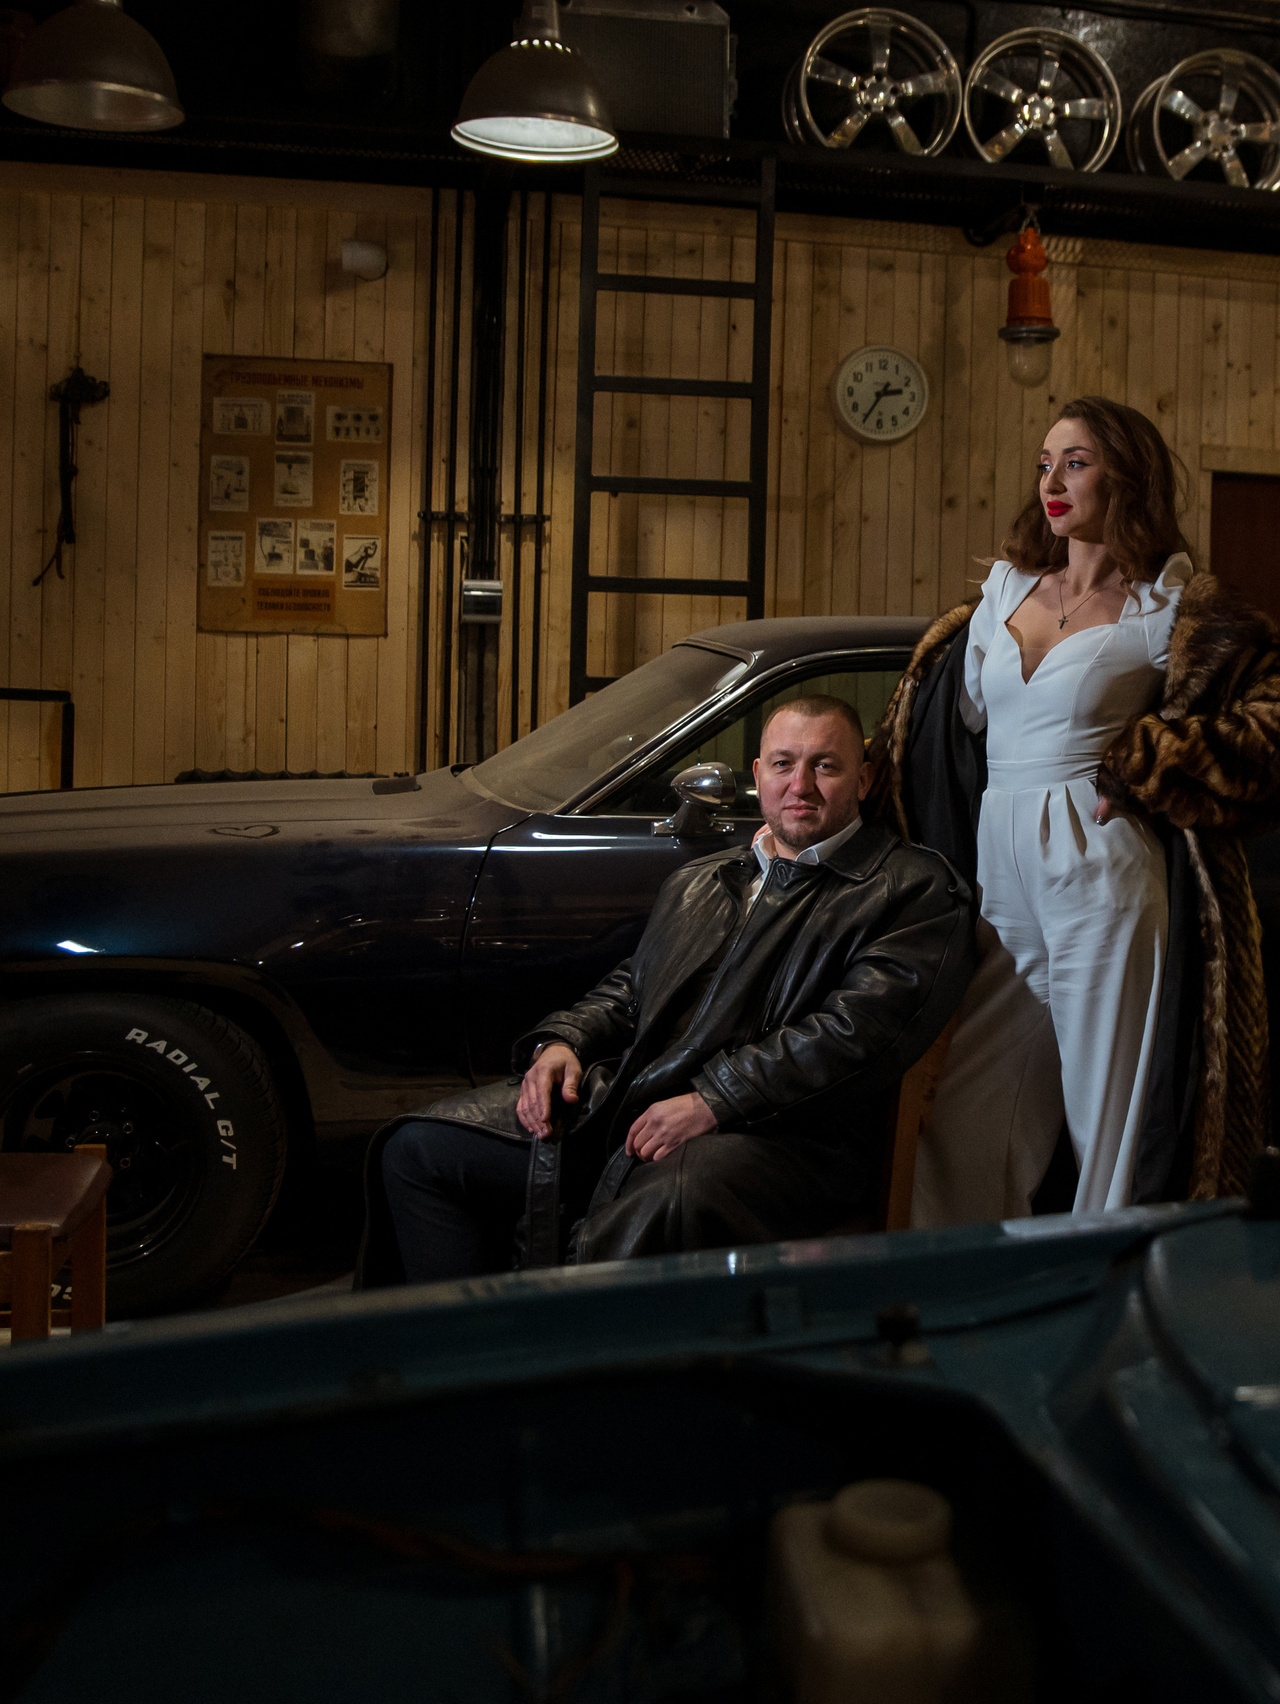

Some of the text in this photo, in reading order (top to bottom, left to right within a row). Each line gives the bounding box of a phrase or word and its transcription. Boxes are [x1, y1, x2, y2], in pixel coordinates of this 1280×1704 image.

[865, 362, 873, 372] 11
[879, 359, 888, 370] 12
[853, 372, 863, 383] 10
[904, 376, 911, 387] 2
[847, 386, 854, 397] 9
[910, 392, 916, 402] 3
[852, 402, 859, 412] 8
[902, 406, 910, 416] 4
[876, 418, 883, 429] 6
[891, 416, 898, 426] 5
[124, 1027, 238, 1170] RADIAL G/T
